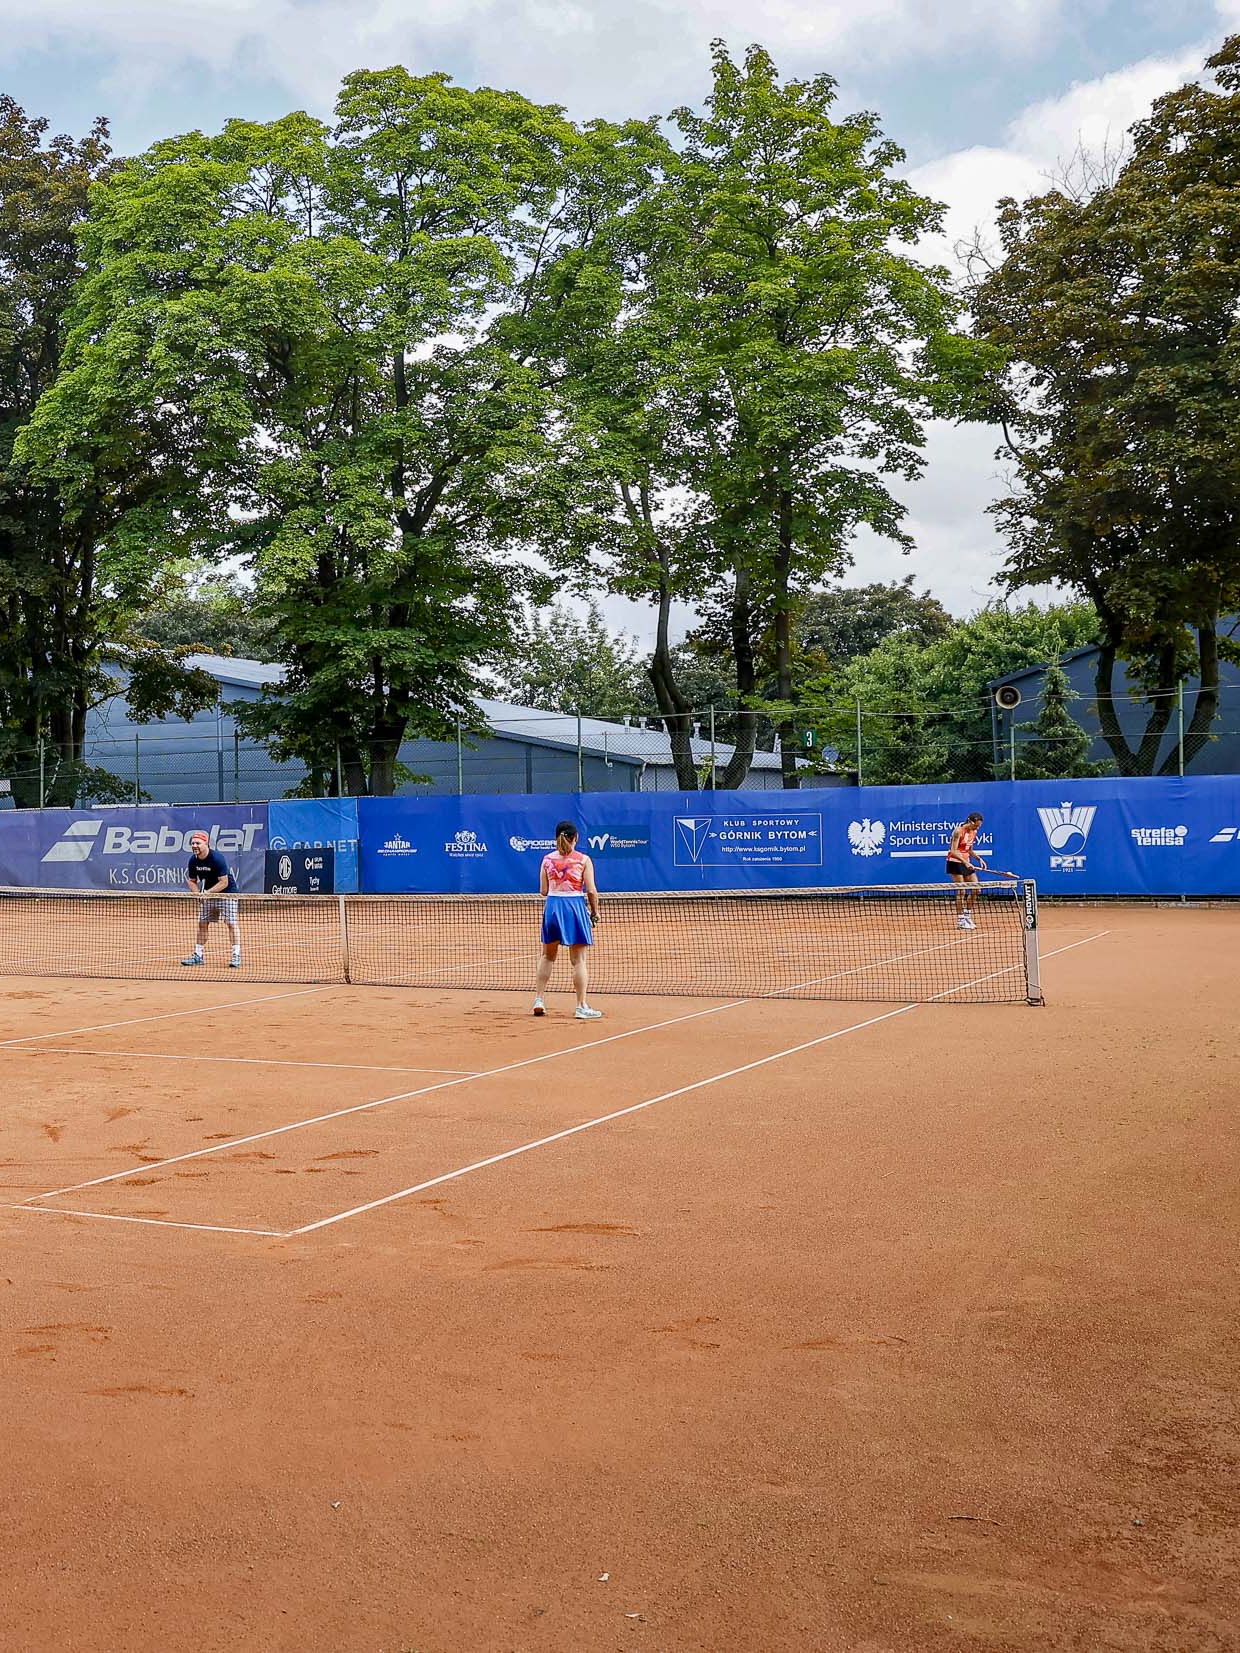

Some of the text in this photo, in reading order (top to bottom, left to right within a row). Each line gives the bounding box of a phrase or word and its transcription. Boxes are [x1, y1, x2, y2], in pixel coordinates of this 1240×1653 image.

[806, 731, 813, 747] 3
[752, 819, 799, 827] SPORTOWY
[719, 829, 807, 840] GÓRNIK BYTOM
[1131, 827, 1175, 838] strefa
[889, 834, 928, 848] Sportu
[938, 832, 993, 846] Tuyki
[1137, 837, 1184, 846] tenisa
[445, 842, 488, 852] FESTINA
[1050, 855, 1087, 868] PZT
[110, 867, 132, 885] K.S.
